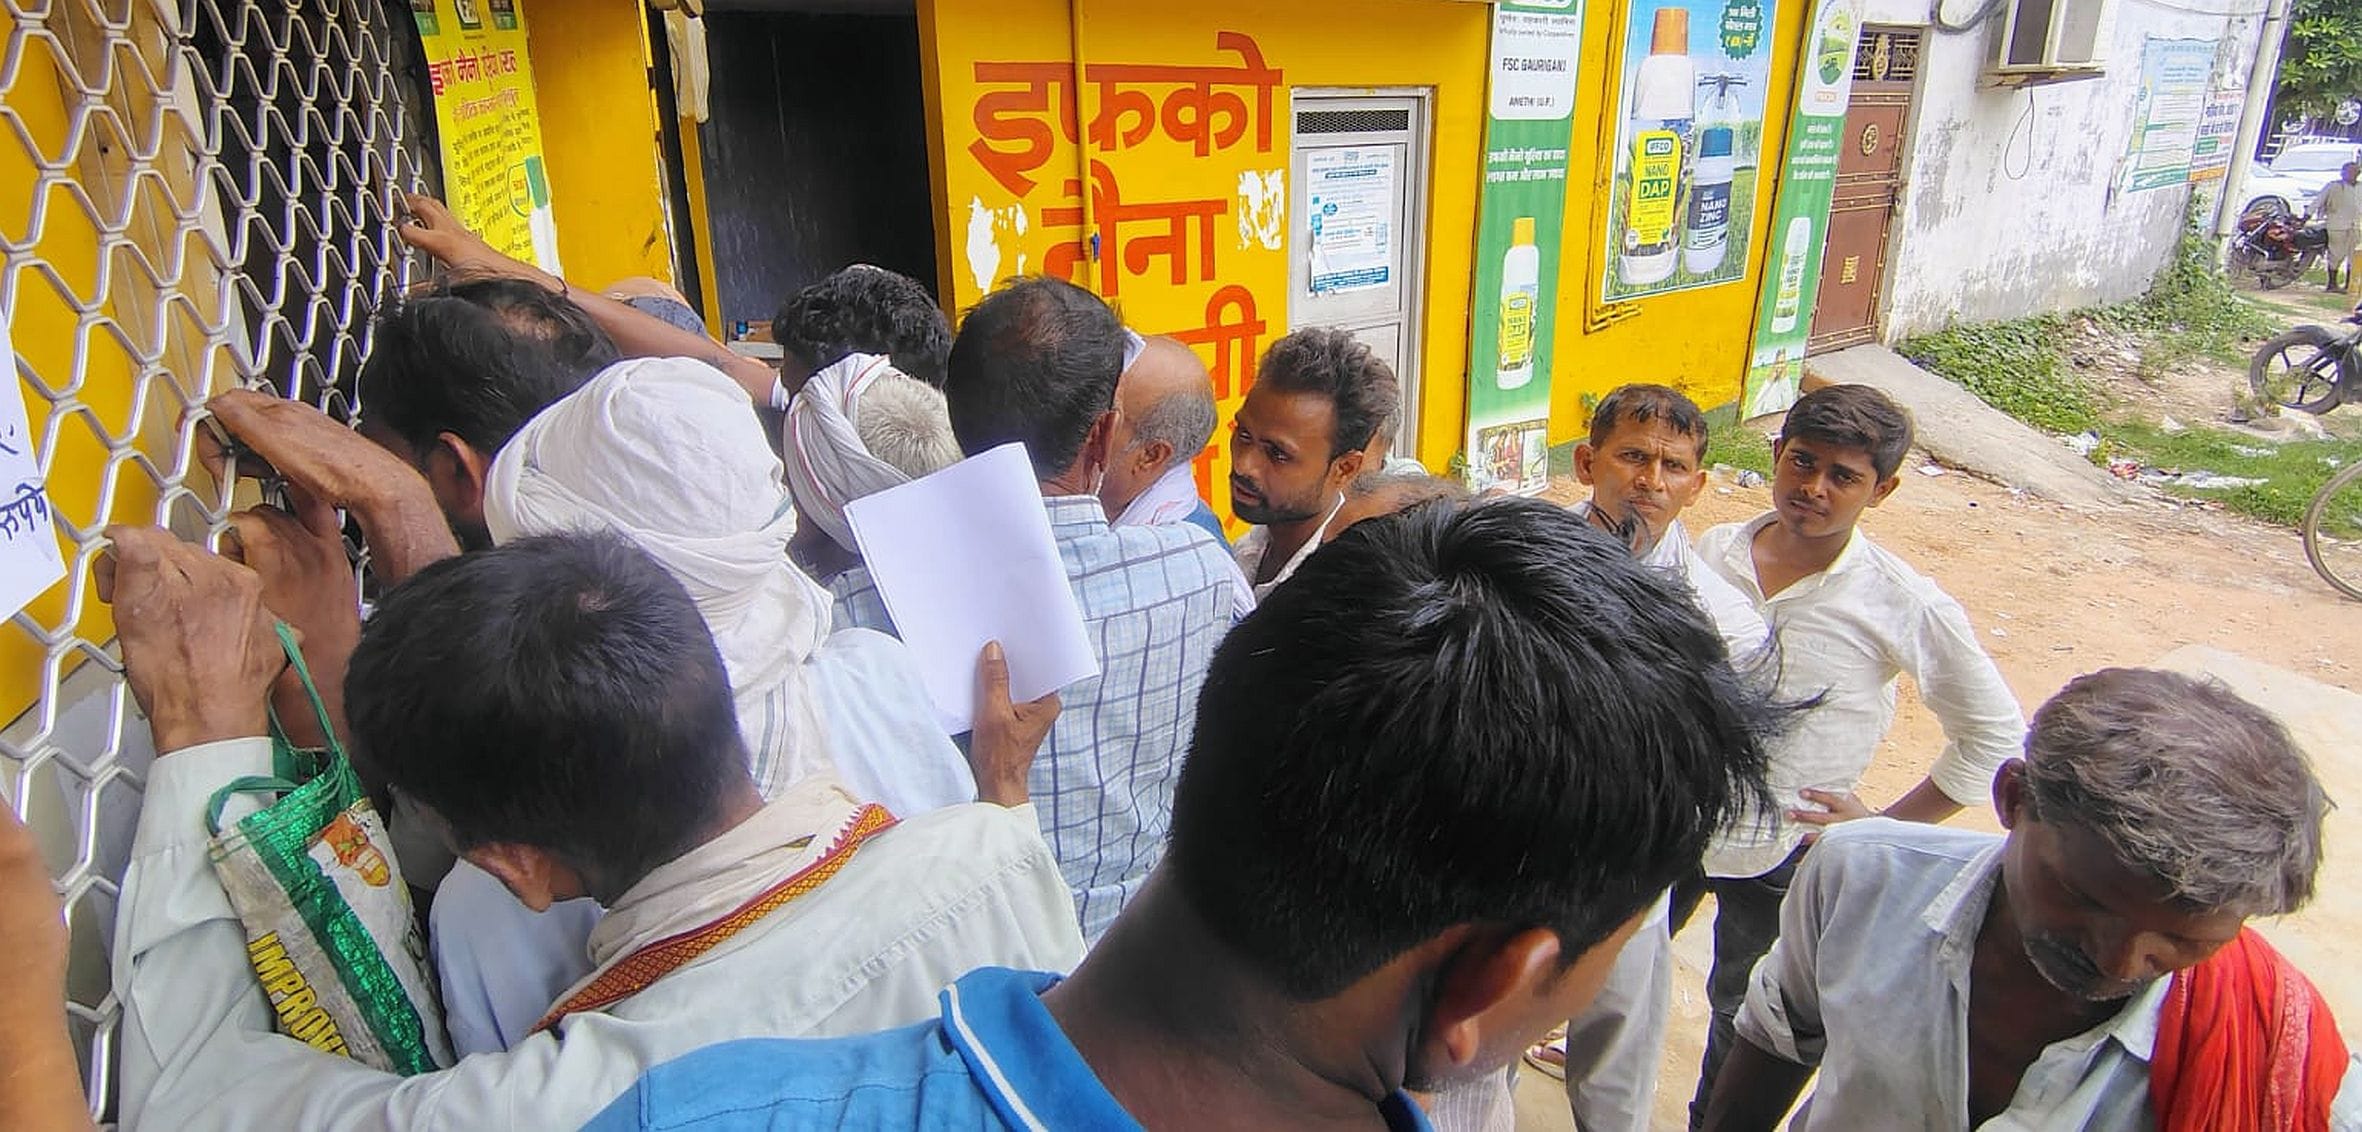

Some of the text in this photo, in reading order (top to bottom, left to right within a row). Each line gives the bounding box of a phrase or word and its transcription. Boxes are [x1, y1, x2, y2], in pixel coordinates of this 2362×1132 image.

[1502, 57, 1520, 72] FSC
[968, 31, 1284, 198] इफको
[1645, 164, 1669, 177] NANO
[1640, 180, 1670, 198] DAP
[1701, 198, 1727, 212] NANO
[1699, 211, 1723, 224] ZINC
